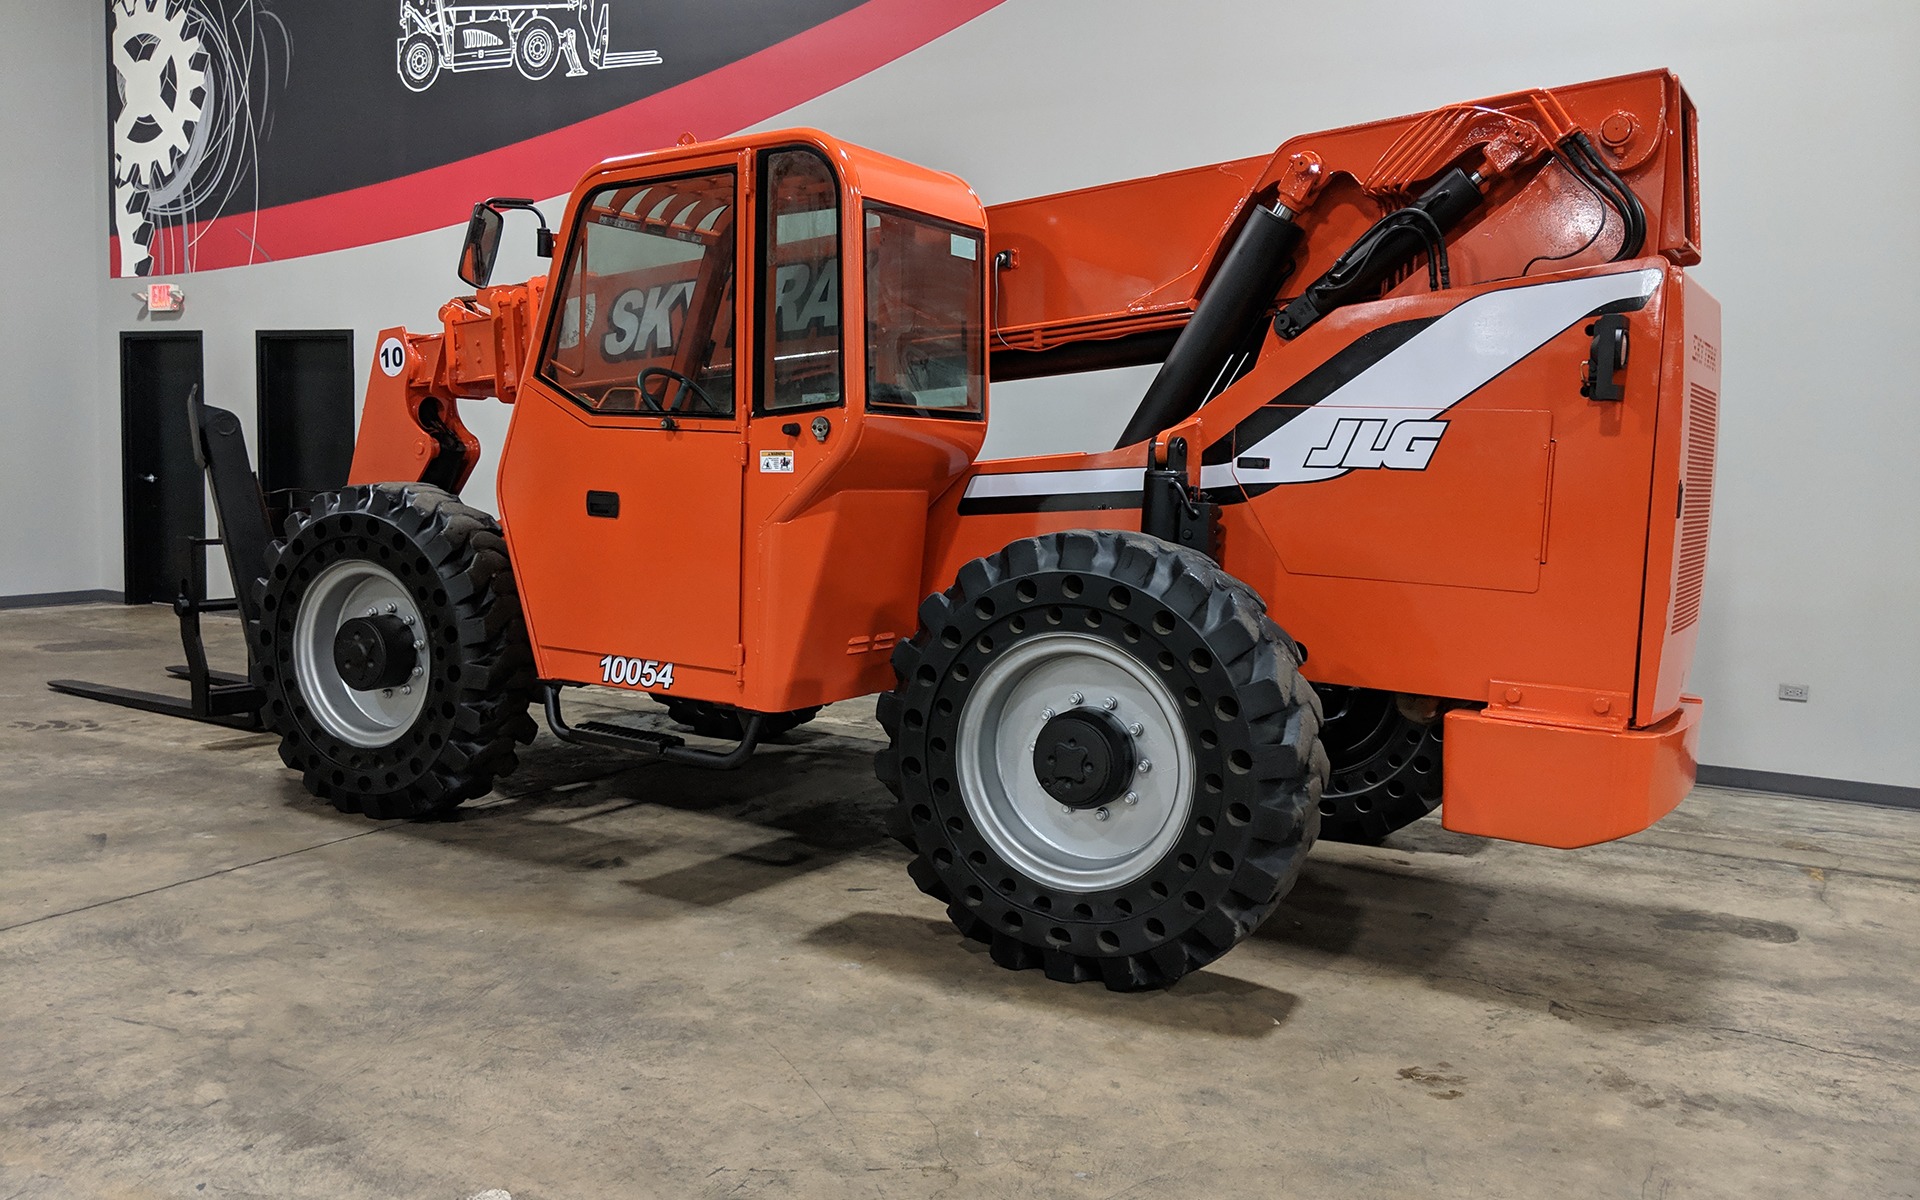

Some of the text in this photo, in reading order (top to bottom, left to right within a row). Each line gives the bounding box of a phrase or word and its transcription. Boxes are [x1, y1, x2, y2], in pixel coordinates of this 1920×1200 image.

[152, 284, 170, 306] EXIT
[381, 346, 403, 368] 10
[1303, 418, 1451, 471] JLG
[600, 655, 674, 689] 10054
